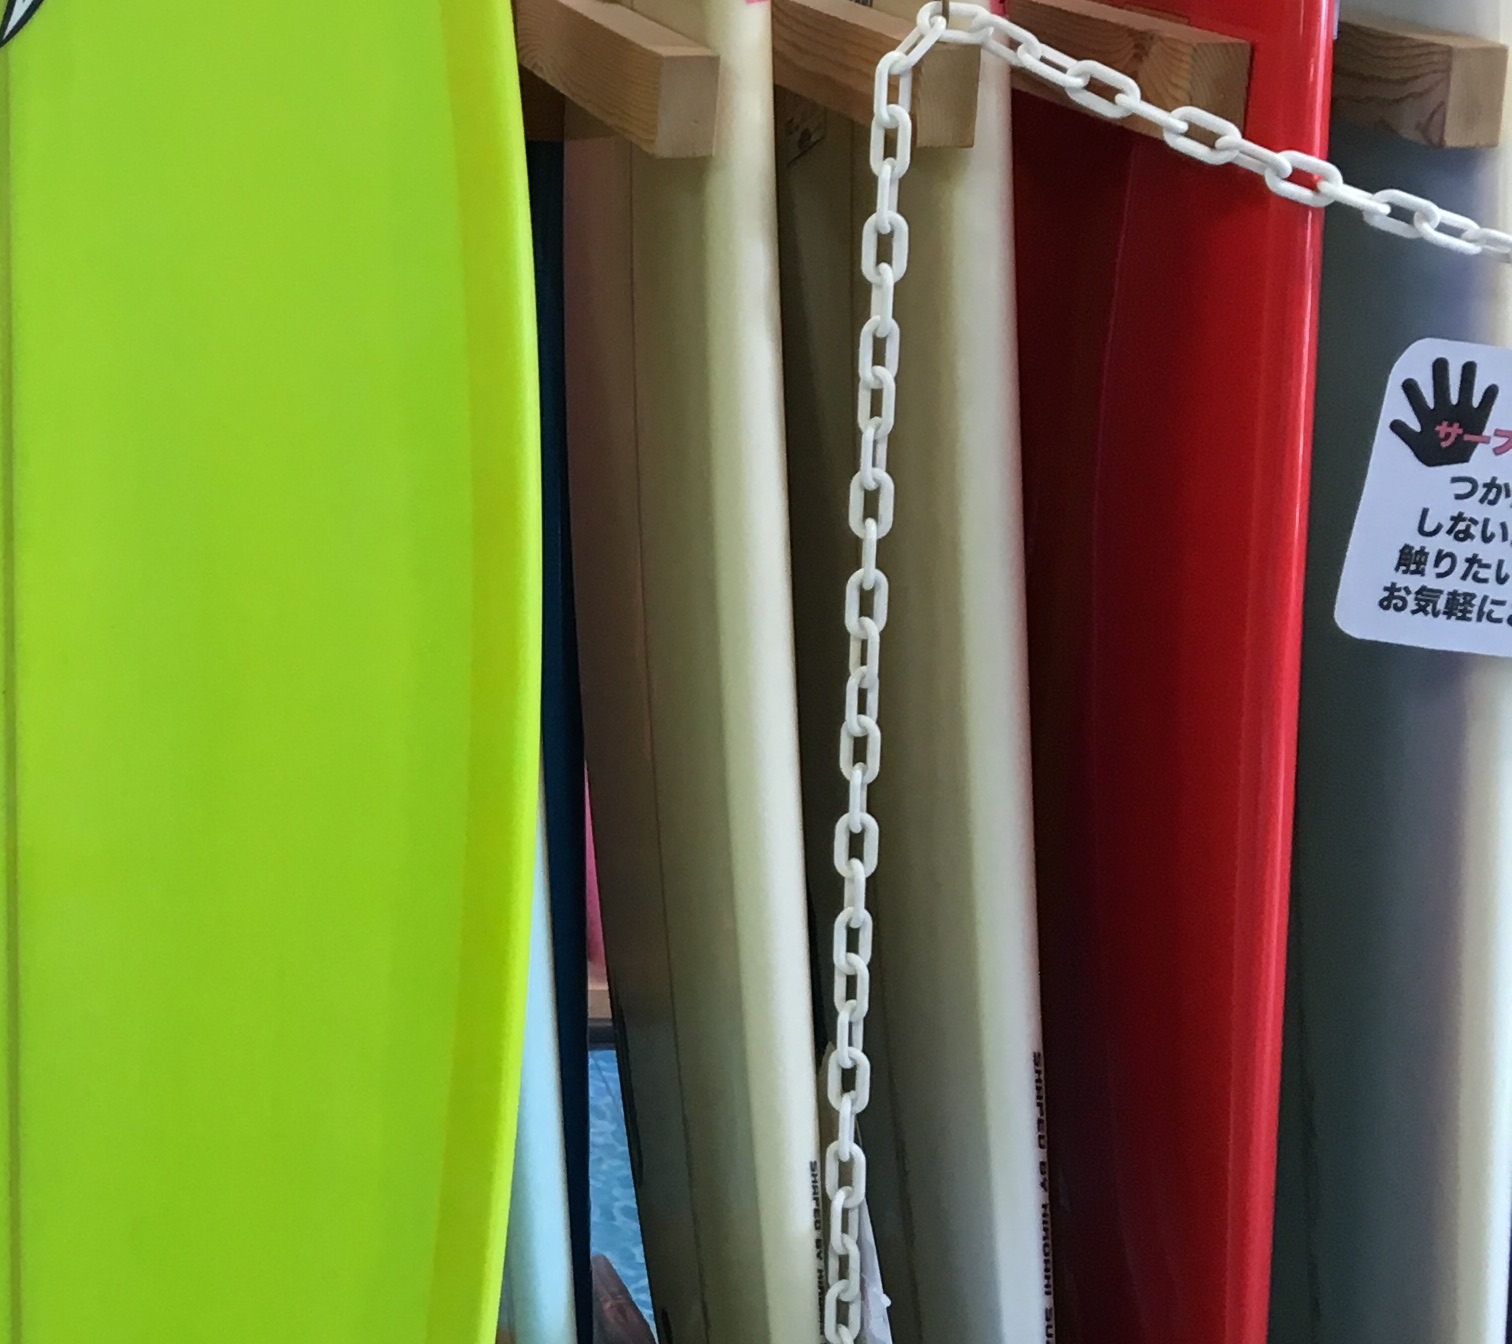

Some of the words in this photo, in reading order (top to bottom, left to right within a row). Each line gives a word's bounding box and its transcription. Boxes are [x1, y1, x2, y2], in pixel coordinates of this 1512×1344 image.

[1450, 475, 1512, 508] つか
[1417, 507, 1512, 545] しない
[1378, 582, 1512, 627] お気軽に
